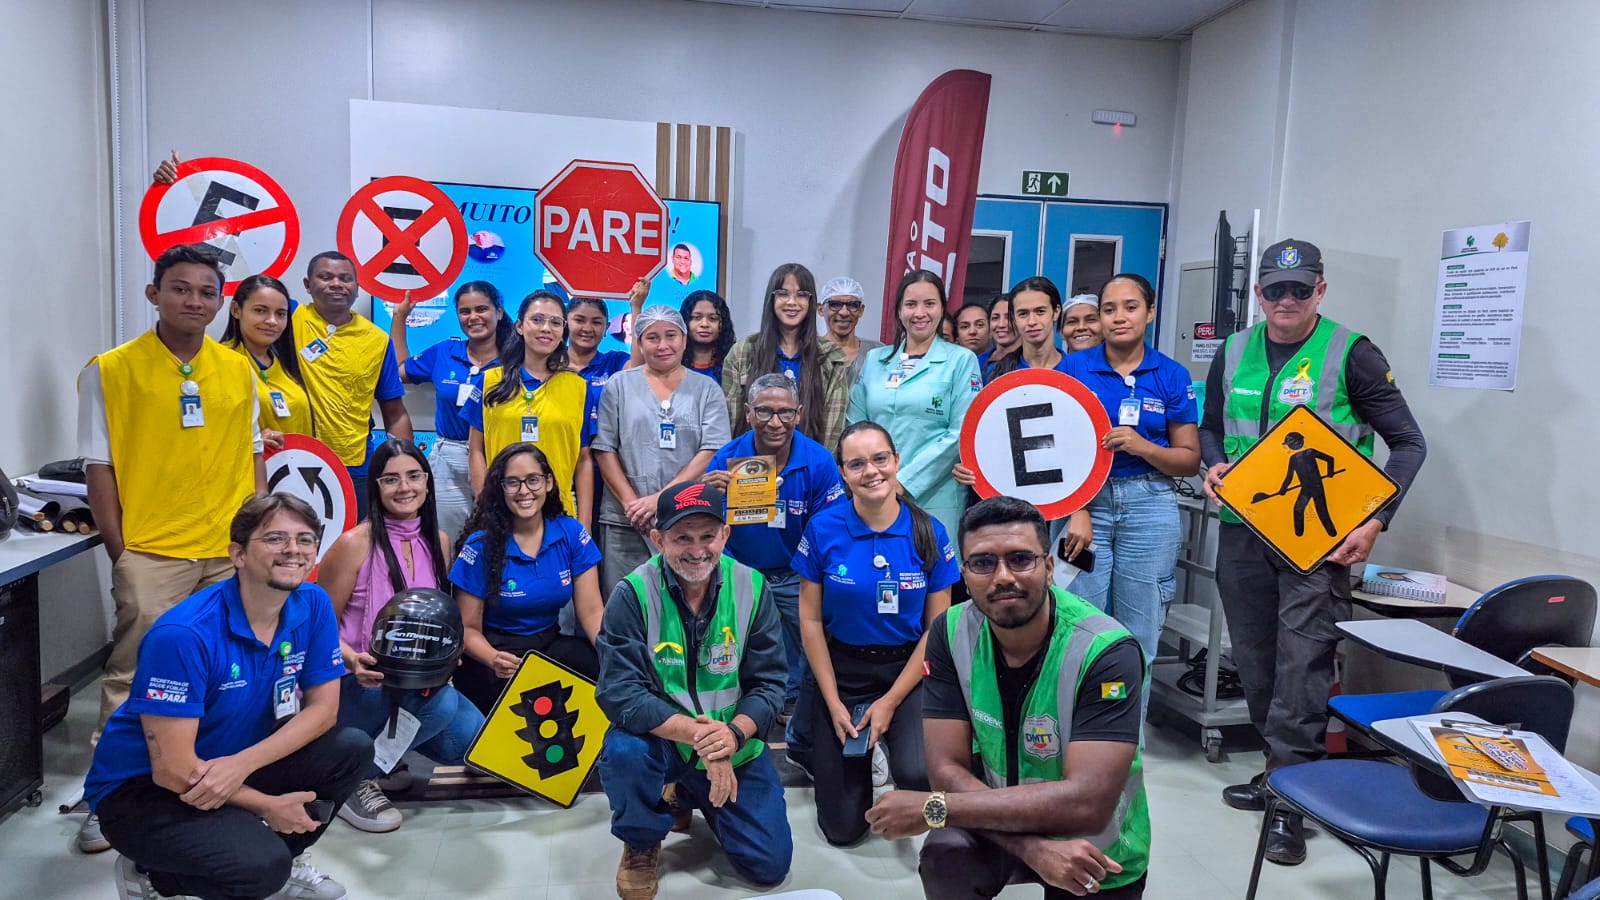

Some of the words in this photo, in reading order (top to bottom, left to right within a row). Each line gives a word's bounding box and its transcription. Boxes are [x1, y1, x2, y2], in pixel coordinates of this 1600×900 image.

[543, 205, 660, 256] PARE
[1006, 402, 1064, 487] E
[675, 498, 712, 510] HONDA
[974, 711, 1003, 729] REDEN
[1025, 733, 1052, 742] DMTT
